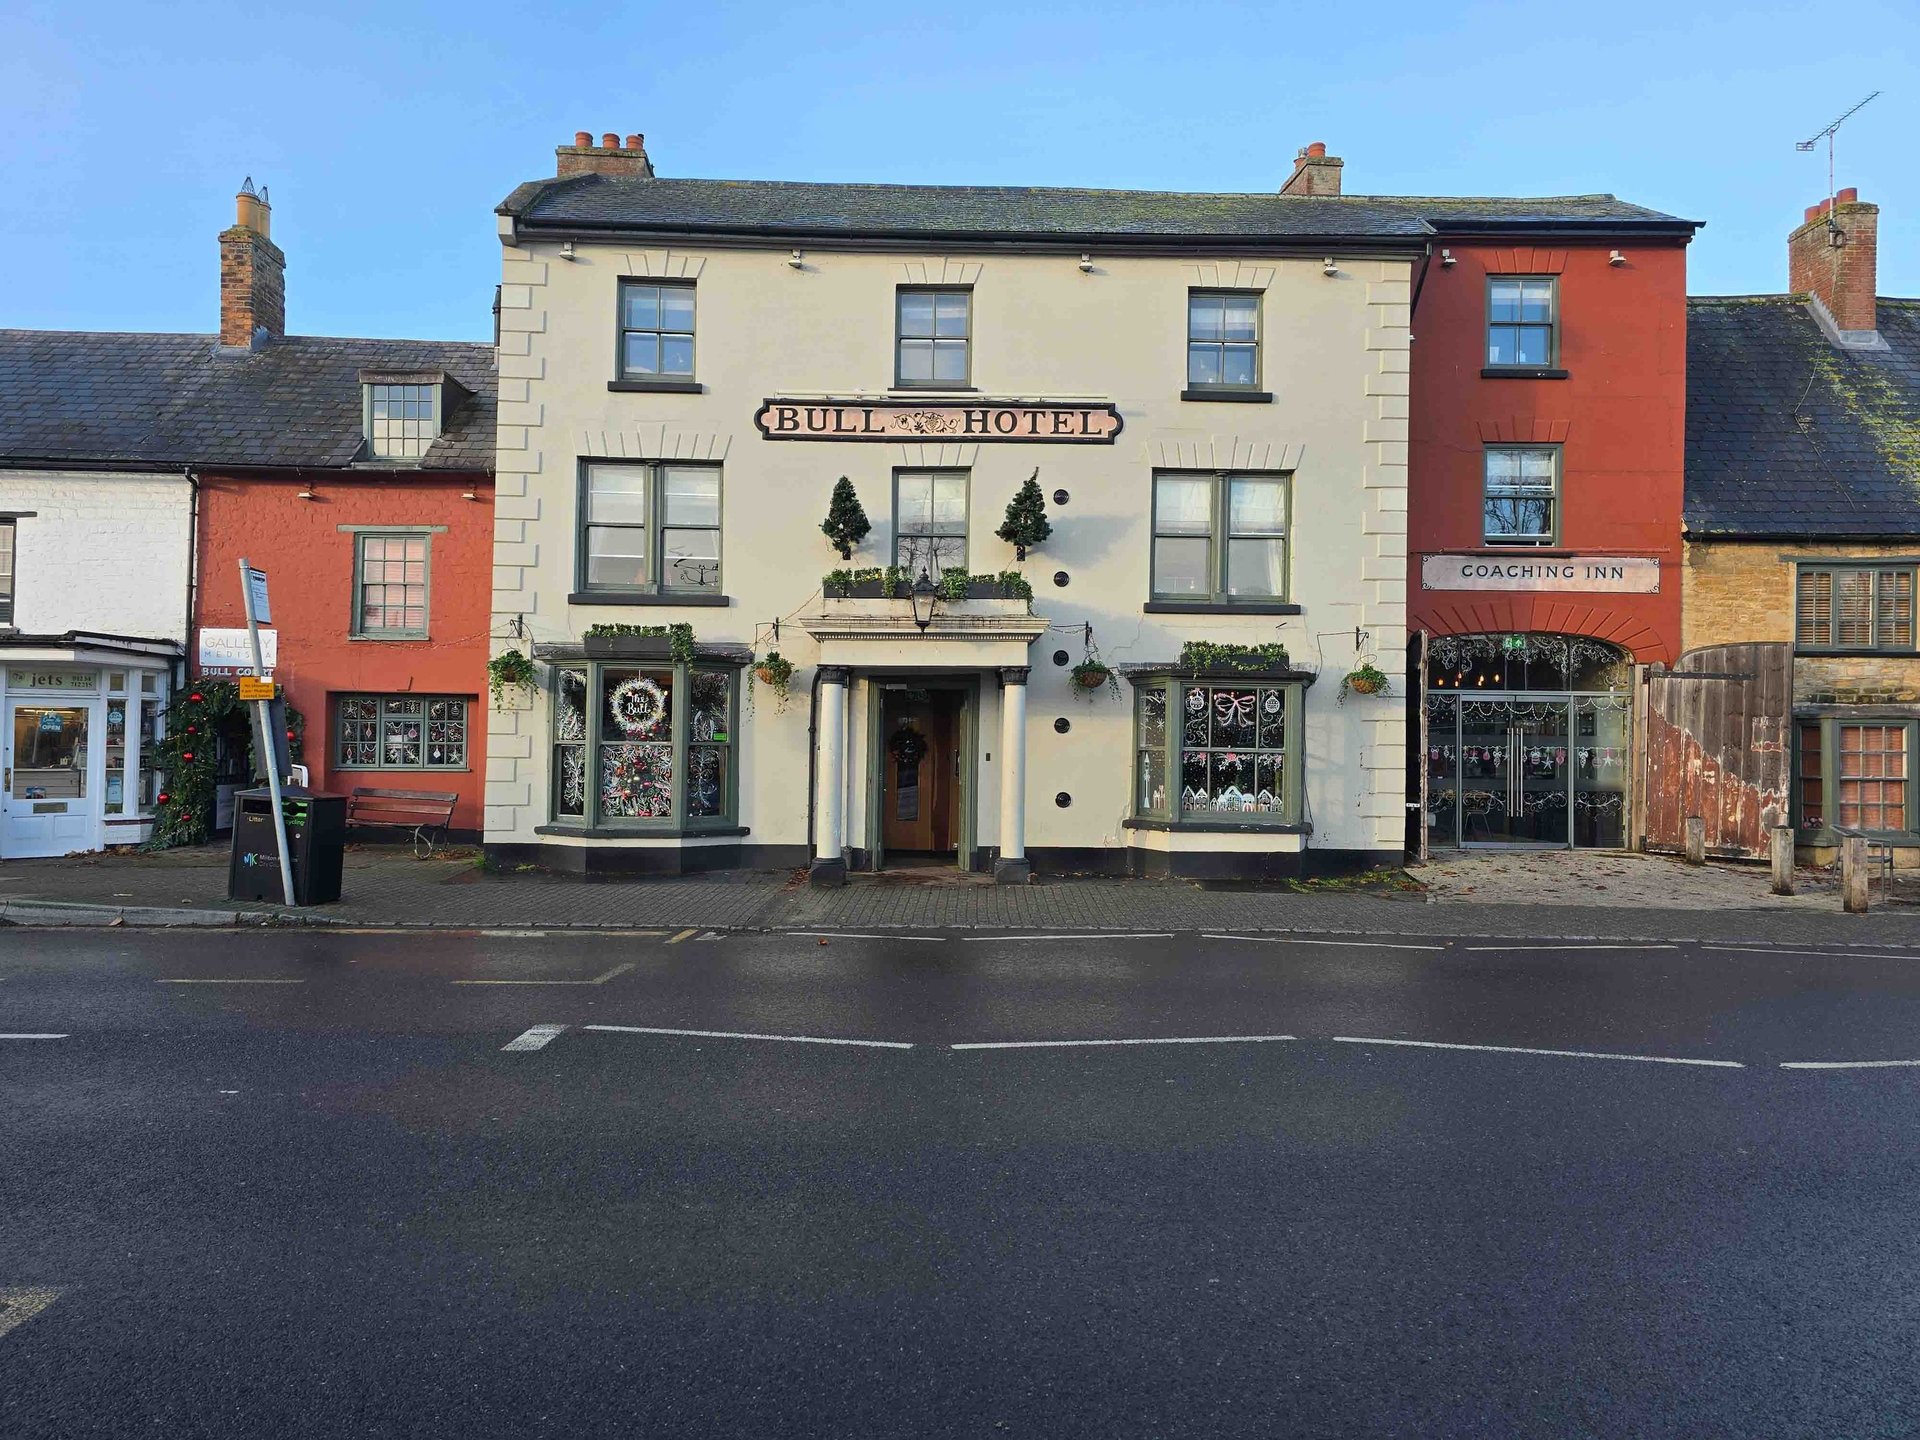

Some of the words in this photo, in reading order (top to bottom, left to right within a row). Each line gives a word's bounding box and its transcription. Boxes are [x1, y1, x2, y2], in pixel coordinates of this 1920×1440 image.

[774, 407, 886, 433] BULL
[963, 409, 1103, 435] HOTEL
[1461, 565, 1574, 579] COACHING
[1585, 566, 1624, 579] INN
[205, 636, 271, 649] GALLEY
[204, 650, 271, 658] MEDISA
[202, 667, 232, 676] BULL
[236, 667, 274, 677] CORT
[30, 673, 63, 687] jets
[630, 694, 649, 703] The
[626, 702, 651, 715] Bull
[243, 852, 259, 867] MK
